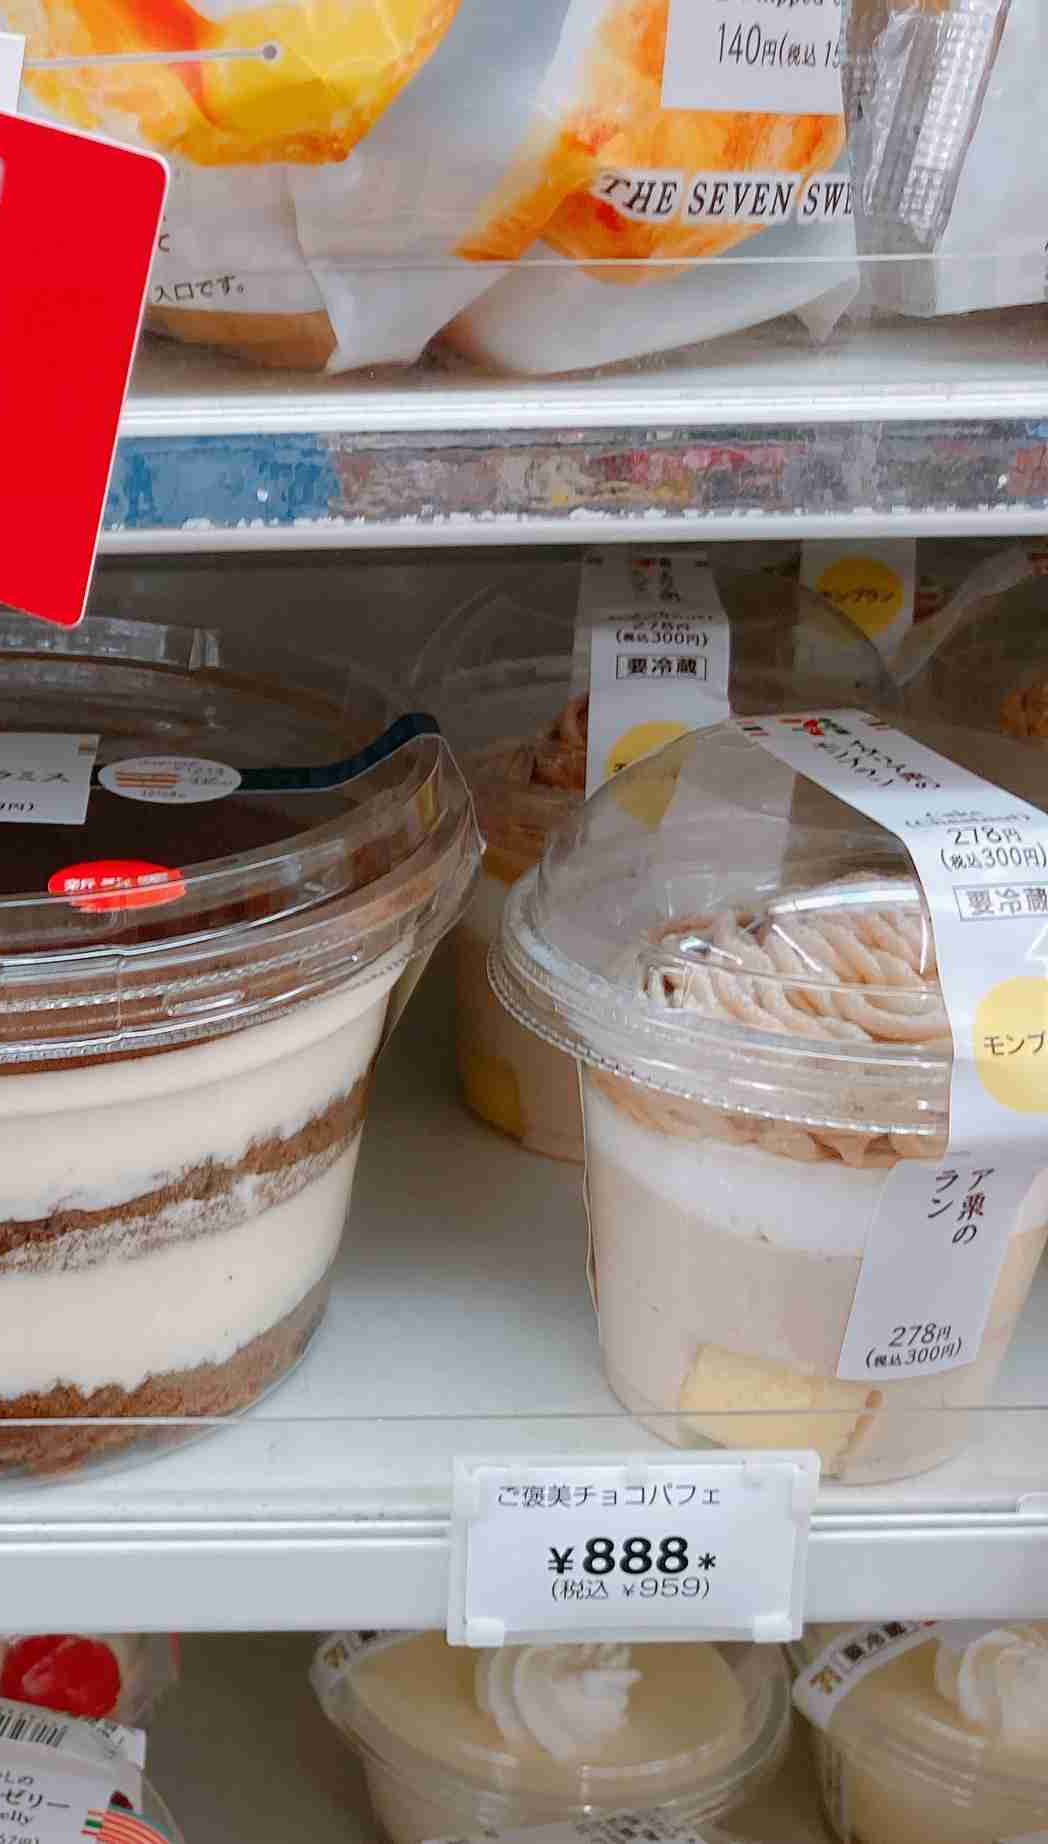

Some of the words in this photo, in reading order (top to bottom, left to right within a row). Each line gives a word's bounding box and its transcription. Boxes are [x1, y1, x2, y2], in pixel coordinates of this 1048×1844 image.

[602, 173, 678, 215] THE
[687, 180, 795, 217] SEVEN
[888, 1322, 952, 1349] 278円
[497, 1484, 721, 1509] ご褒美チョコパフェ
